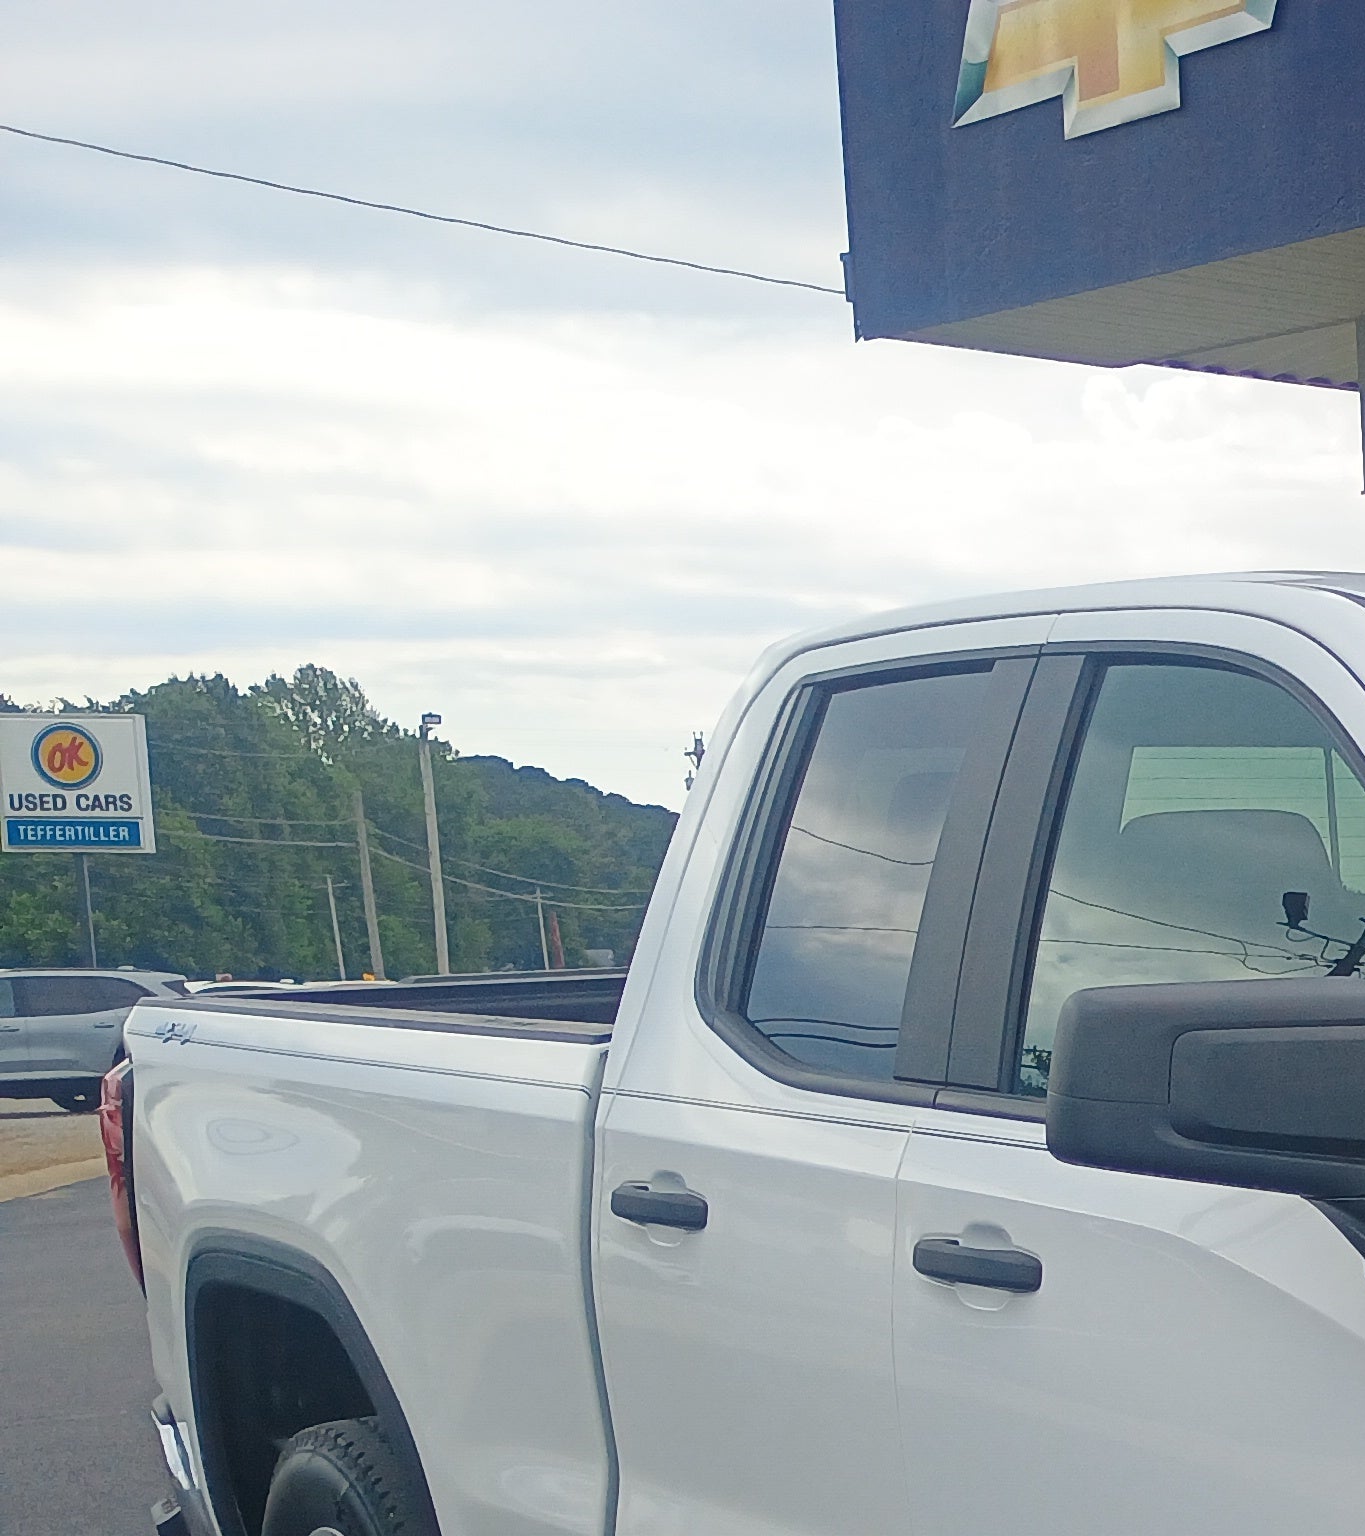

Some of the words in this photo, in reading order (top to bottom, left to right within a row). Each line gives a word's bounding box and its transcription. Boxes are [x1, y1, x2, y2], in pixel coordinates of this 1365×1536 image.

[47, 736, 89, 773] OK
[9, 793, 67, 811] USED
[75, 793, 133, 812] CARS
[18, 825, 129, 841] TEFFERTILLER
